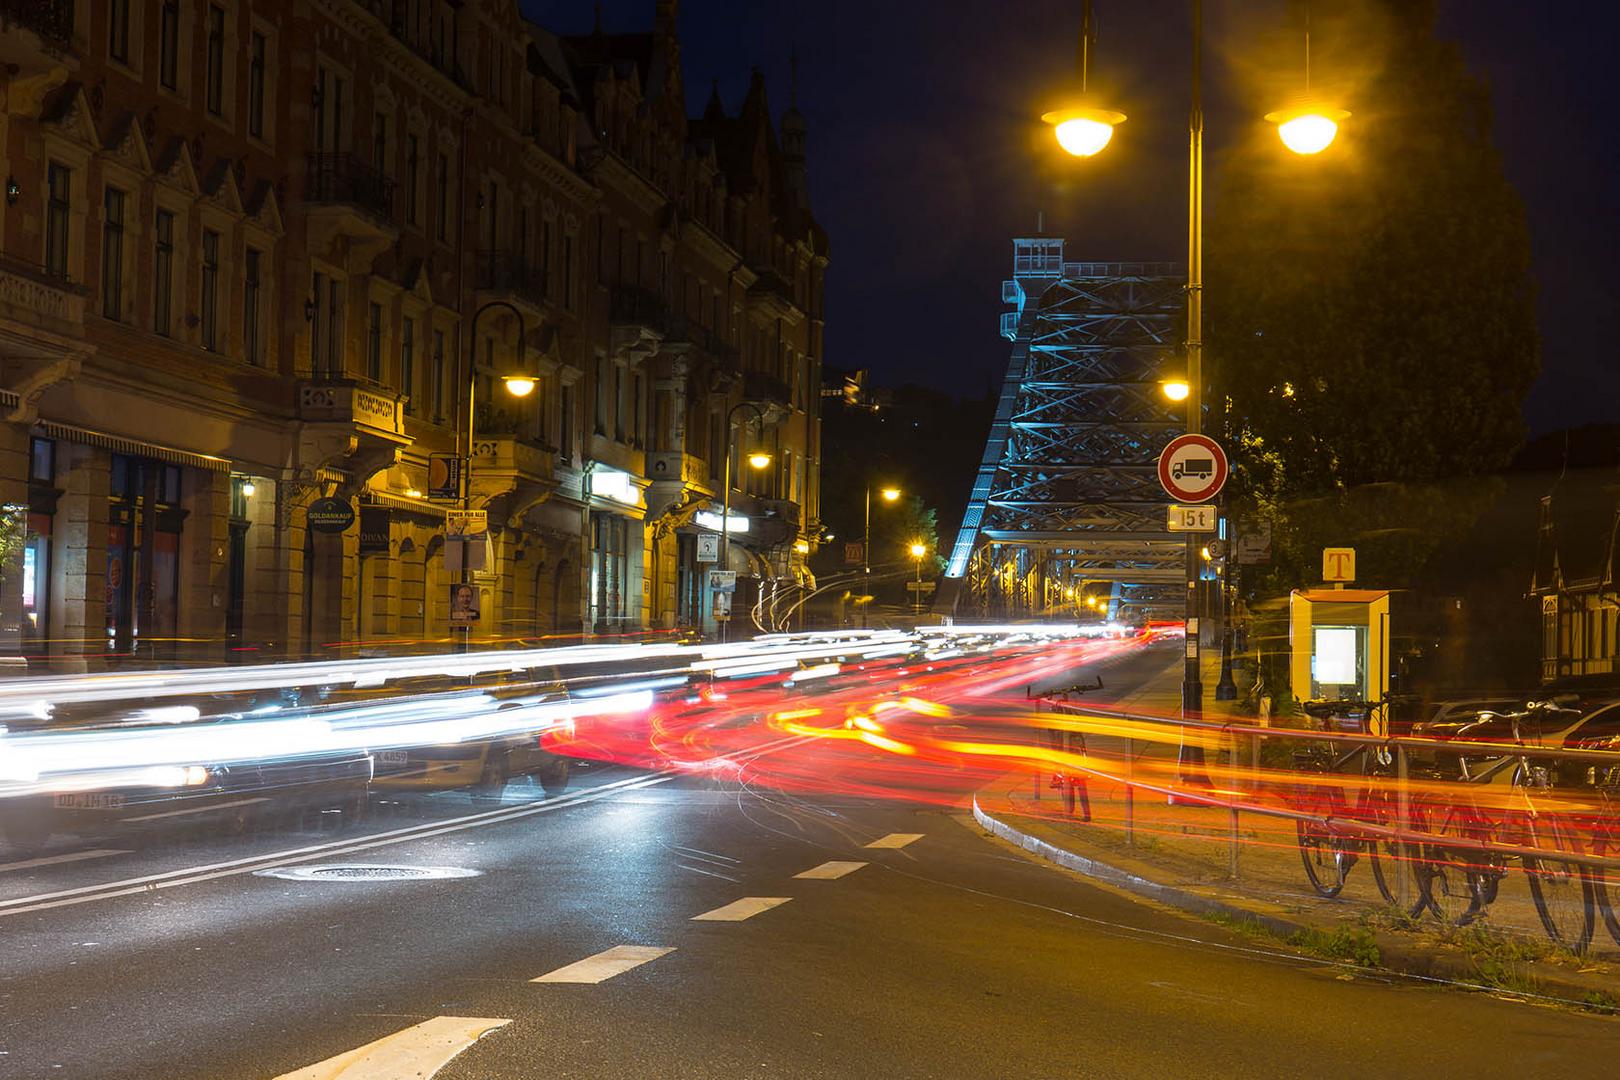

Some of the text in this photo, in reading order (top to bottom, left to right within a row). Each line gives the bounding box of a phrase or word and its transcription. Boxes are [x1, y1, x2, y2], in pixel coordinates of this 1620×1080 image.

[308, 512, 352, 520] GOLDANKAUF
[1181, 510, 1206, 527] 15 t
[1328, 552, 1351, 580] T
